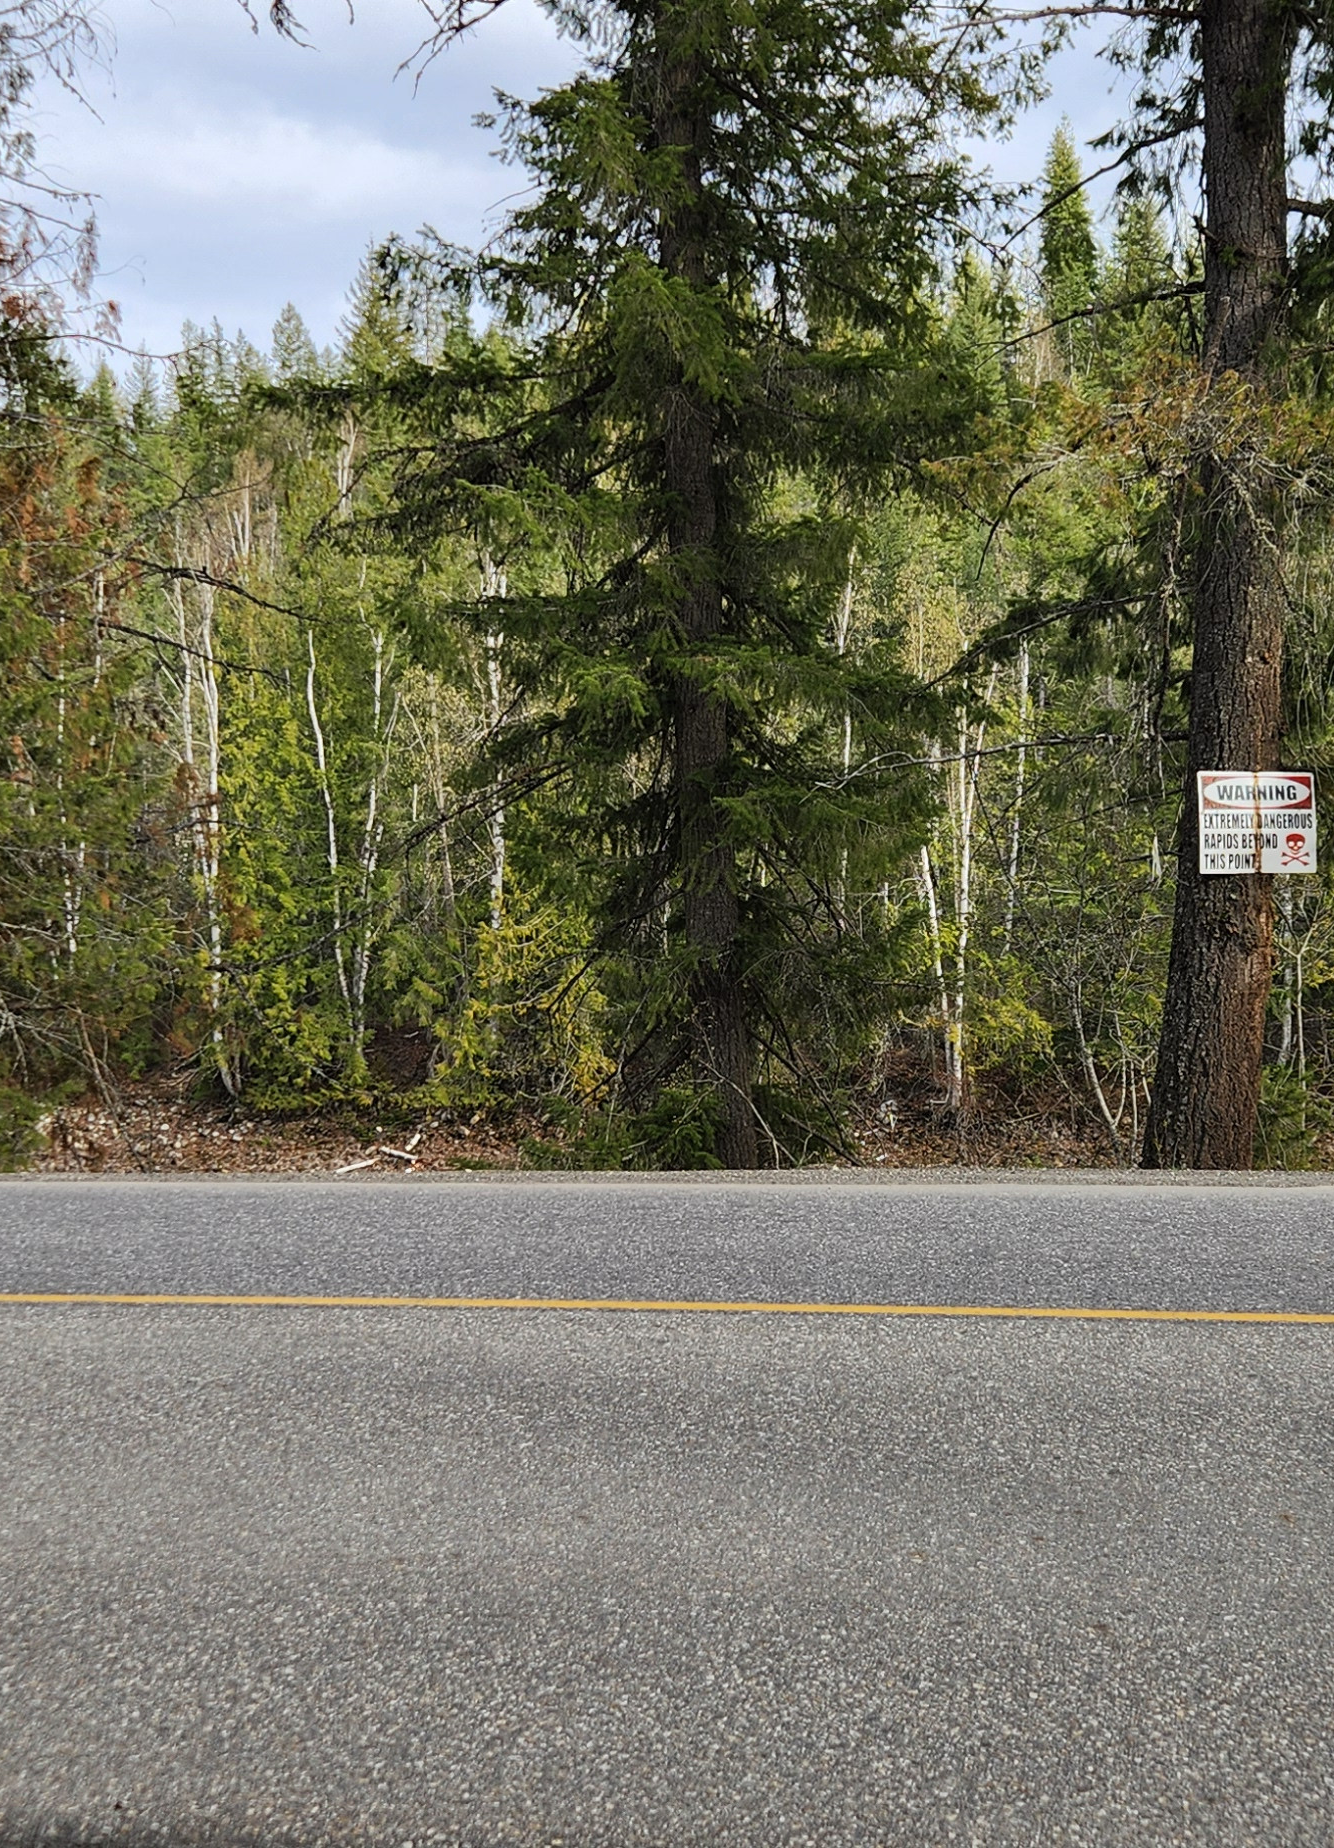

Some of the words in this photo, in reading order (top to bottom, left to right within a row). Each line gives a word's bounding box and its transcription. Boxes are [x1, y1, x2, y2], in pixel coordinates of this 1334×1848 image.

[1216, 785, 1297, 801] WARNING
[1203, 814, 1254, 829] EXTREMELY
[1257, 813, 1313, 829] DANGEROUS
[1204, 833, 1239, 849] RAPIDS
[1241, 833, 1278, 849] BEYOND
[1204, 853, 1226, 869] THIS
[1228, 853, 1256, 869] POINT
